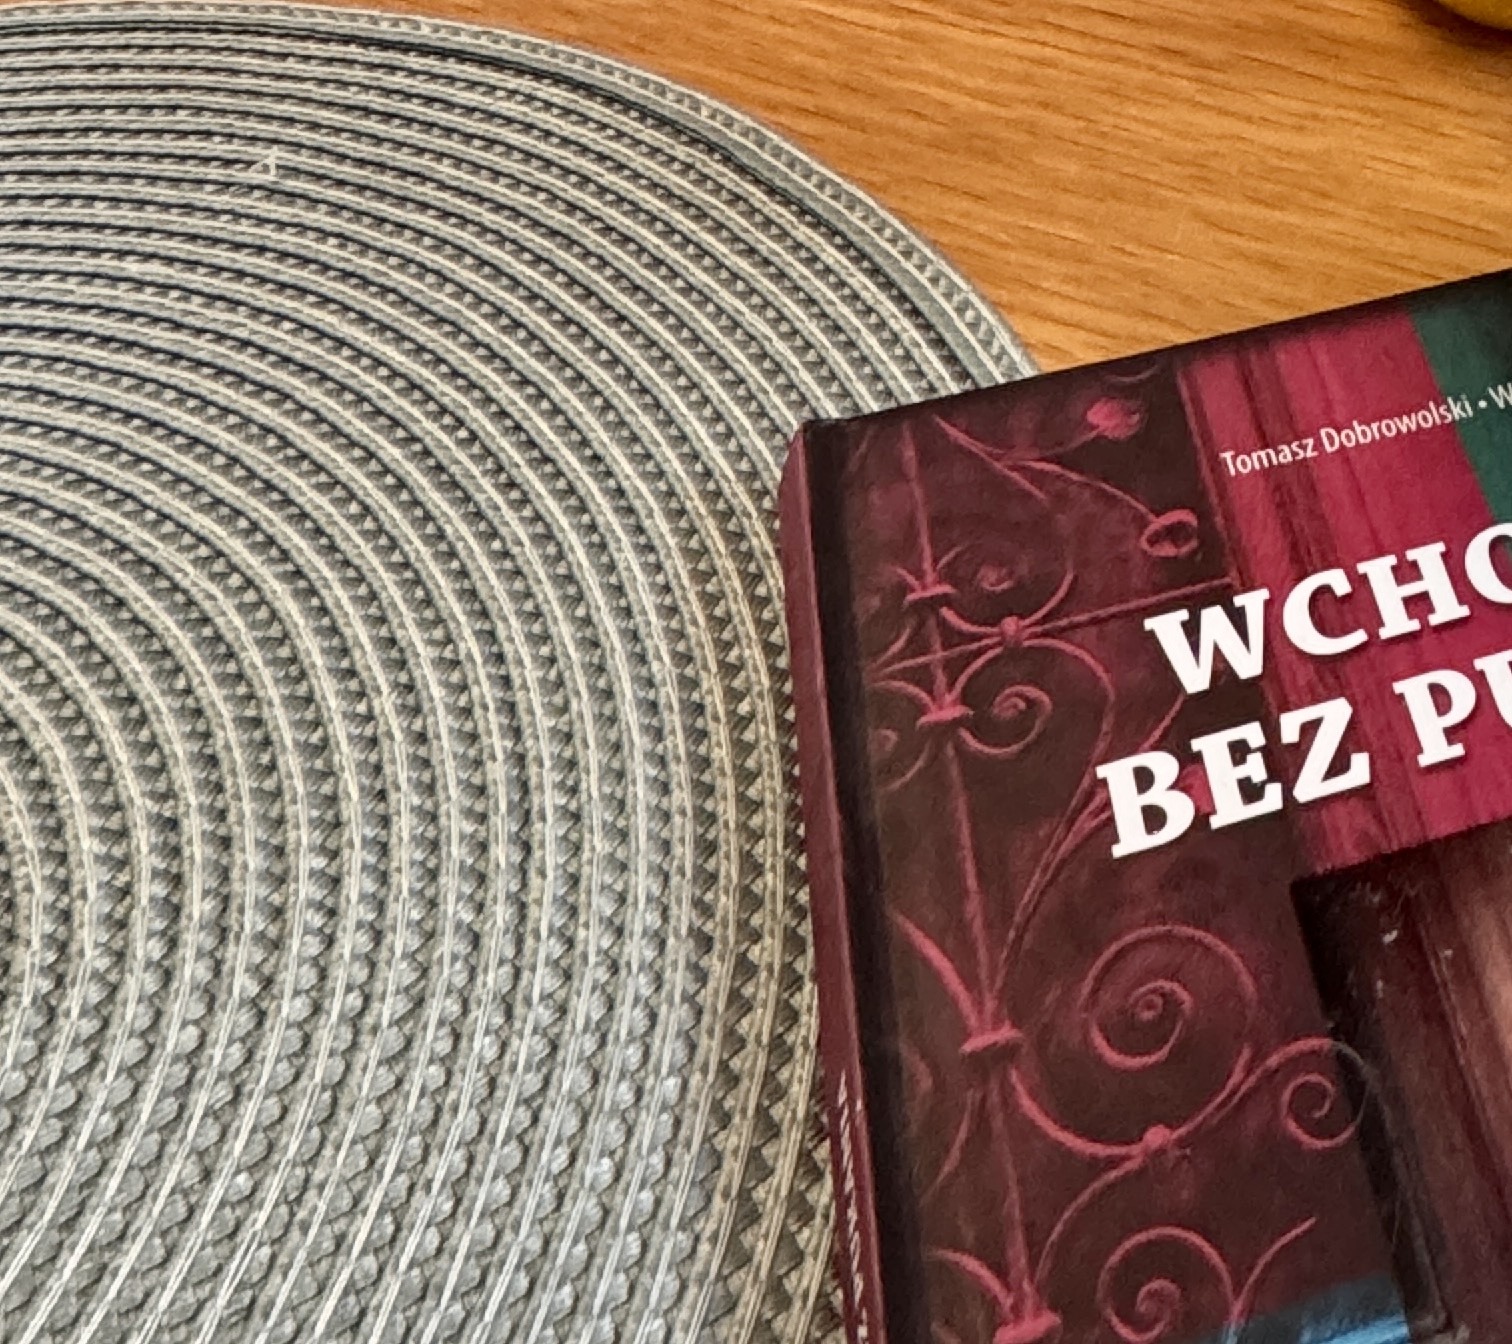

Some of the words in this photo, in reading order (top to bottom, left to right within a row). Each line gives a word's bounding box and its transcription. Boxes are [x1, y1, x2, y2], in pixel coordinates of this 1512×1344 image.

[1219, 436, 1319, 477] Tomasz
[1319, 392, 1474, 454] Dobrowolski
[1095, 696, 1372, 859] BEZ
